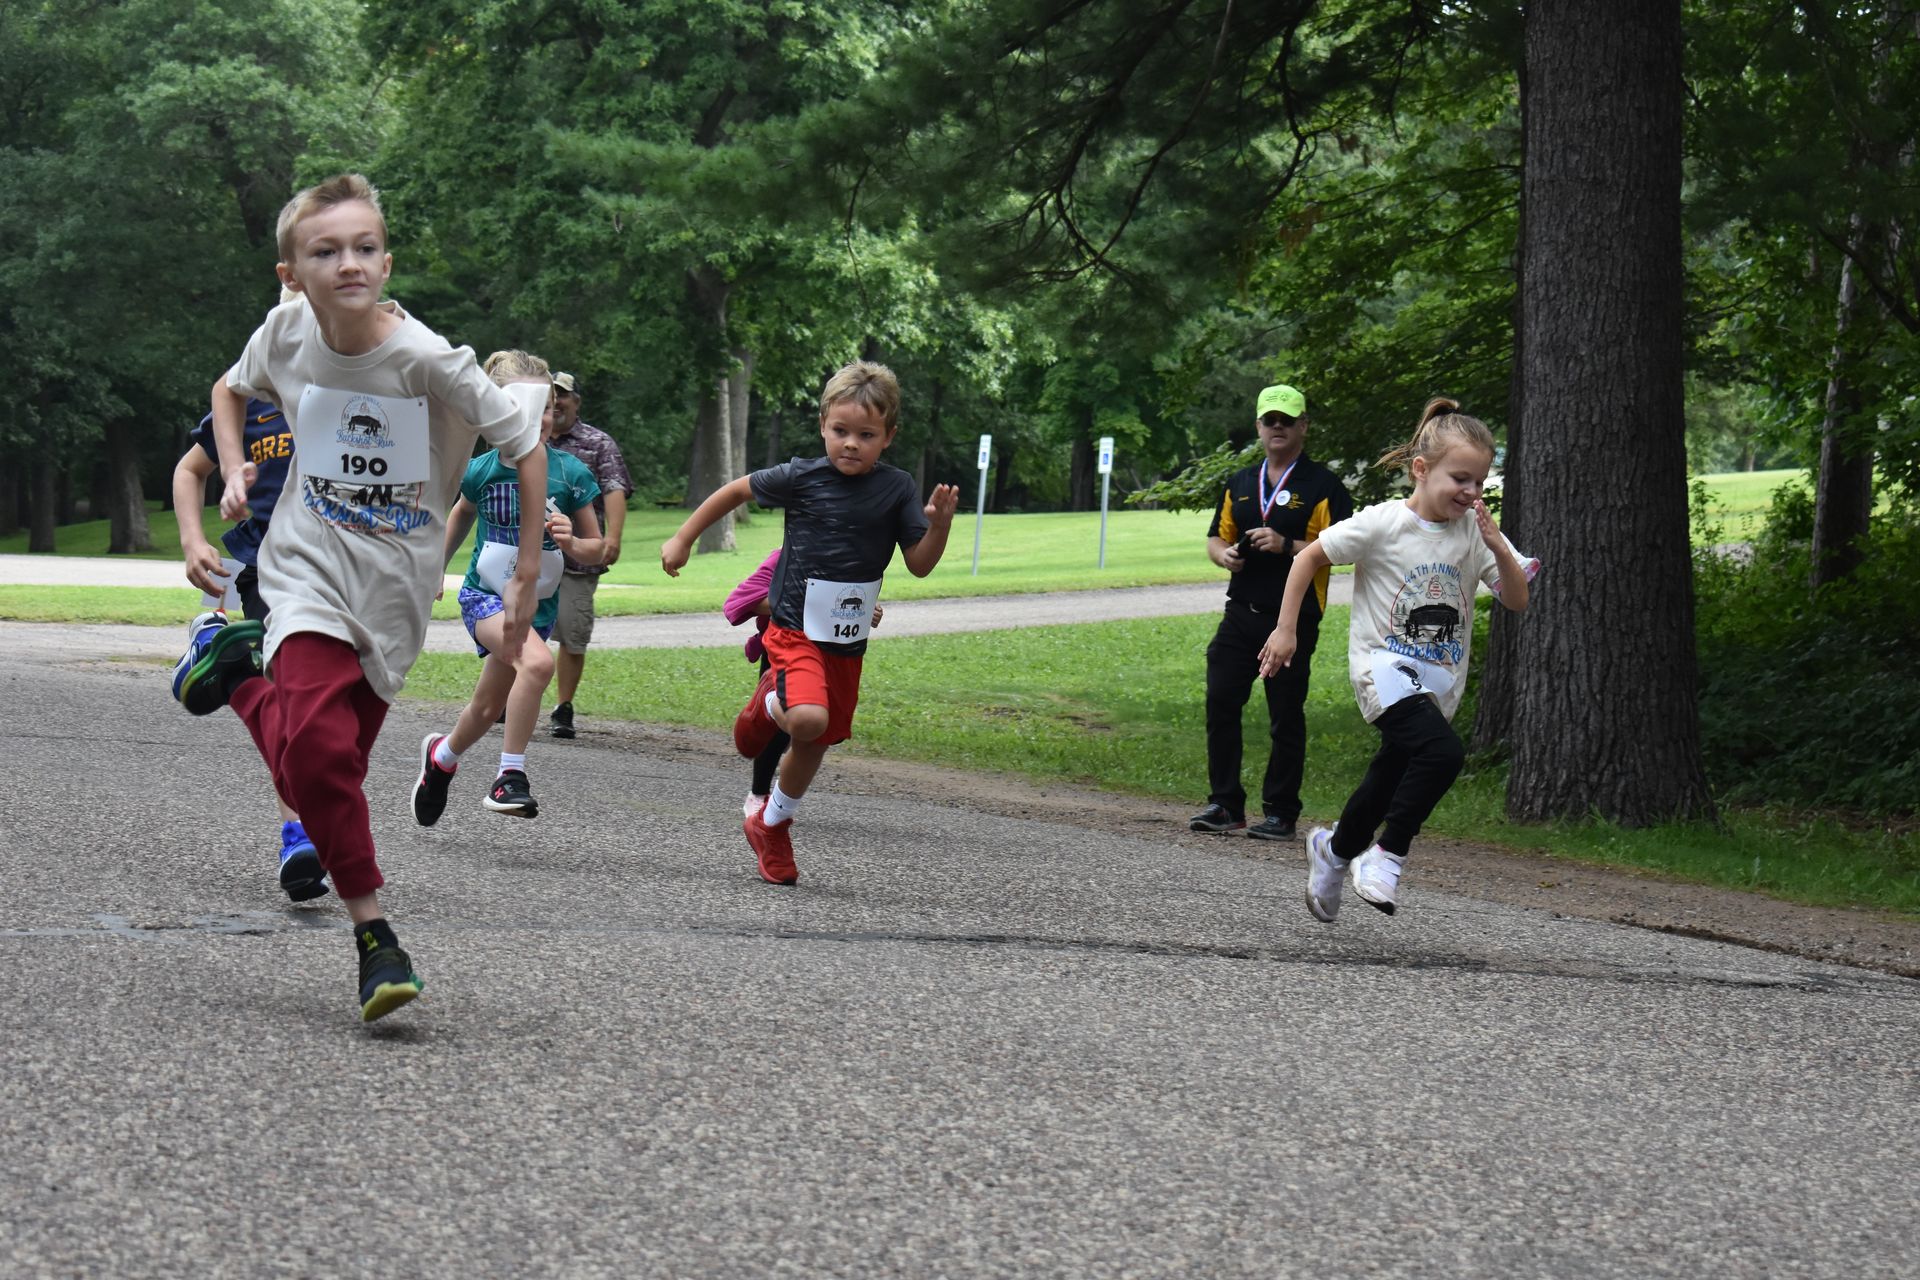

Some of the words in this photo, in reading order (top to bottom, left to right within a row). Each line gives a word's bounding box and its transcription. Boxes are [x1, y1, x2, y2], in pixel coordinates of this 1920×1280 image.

[375, 434, 395, 448] Run
[341, 453, 388, 477] 190
[386, 503, 432, 534] Run
[1404, 563, 1429, 583] 44TH
[1432, 562, 1462, 581] ANNUA
[834, 624, 860, 637] 140
